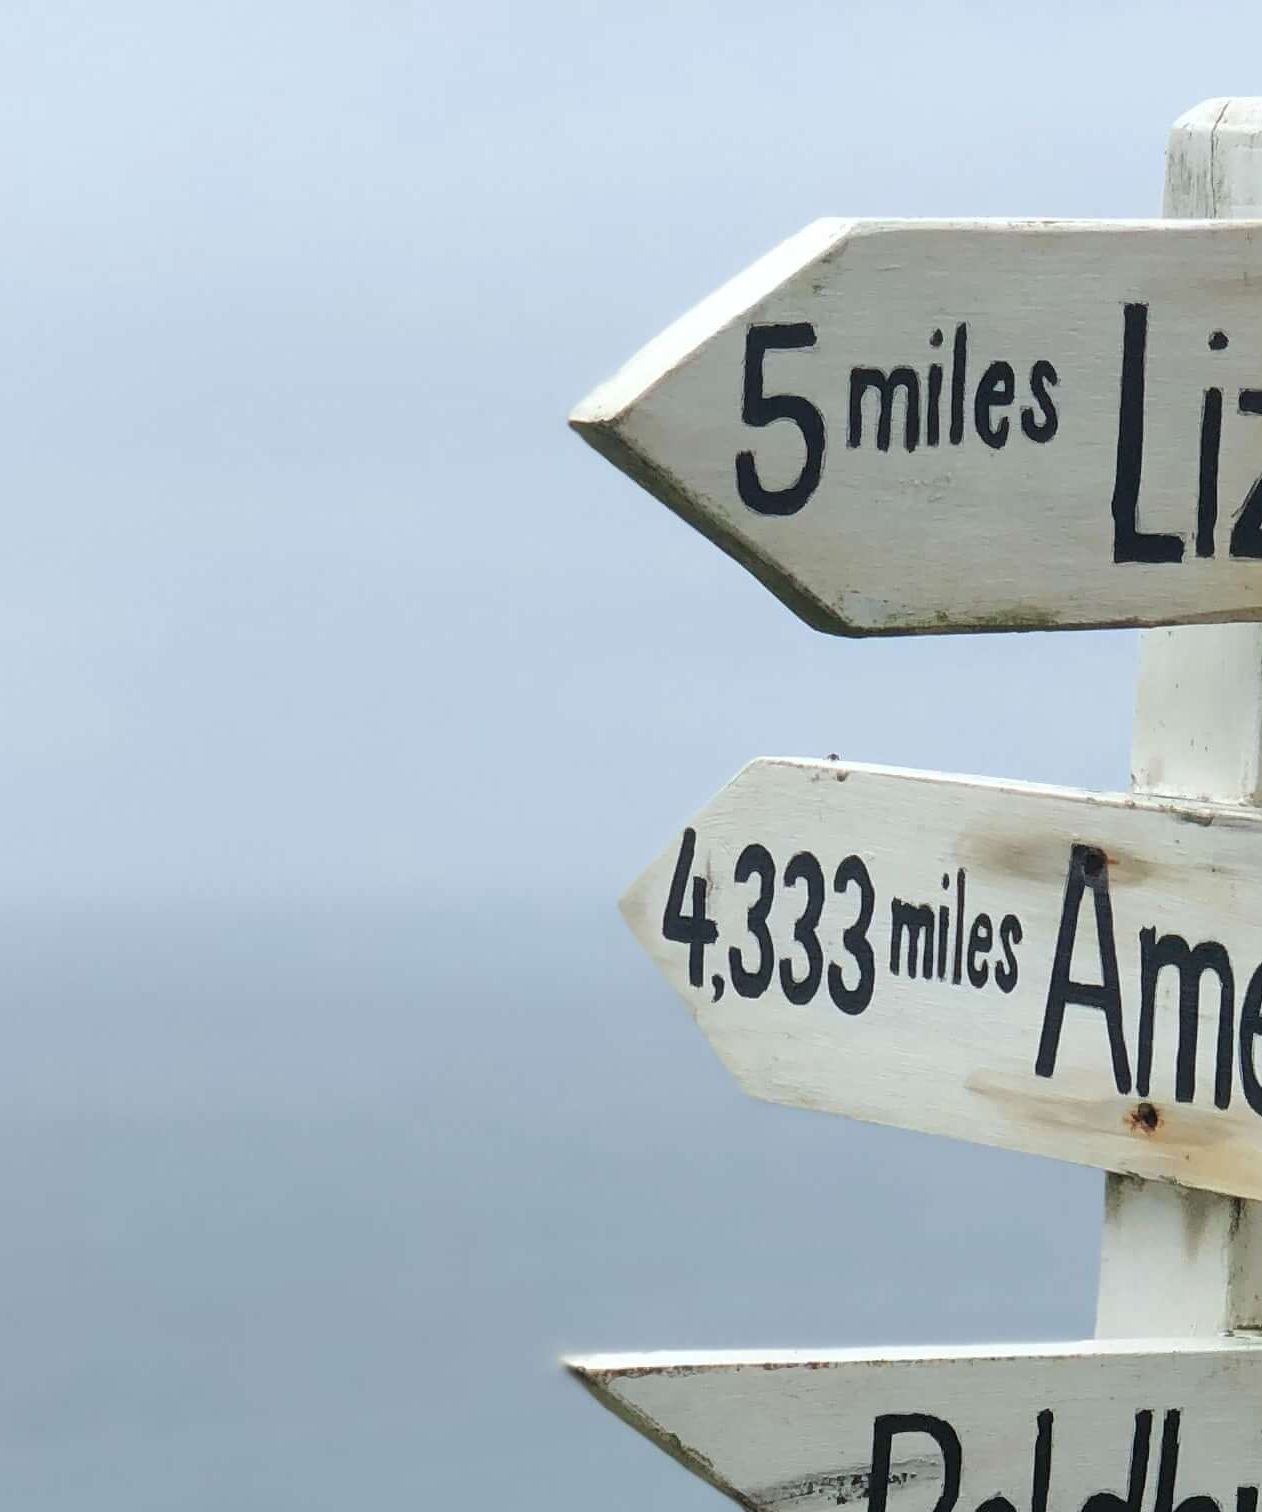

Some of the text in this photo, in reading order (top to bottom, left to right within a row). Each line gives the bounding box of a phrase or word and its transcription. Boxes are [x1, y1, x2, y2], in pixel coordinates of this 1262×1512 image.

[736, 322, 825, 516] 5
[847, 320, 1058, 454] miles
[662, 828, 875, 1016] 4,333
[889, 868, 1023, 994] miles
